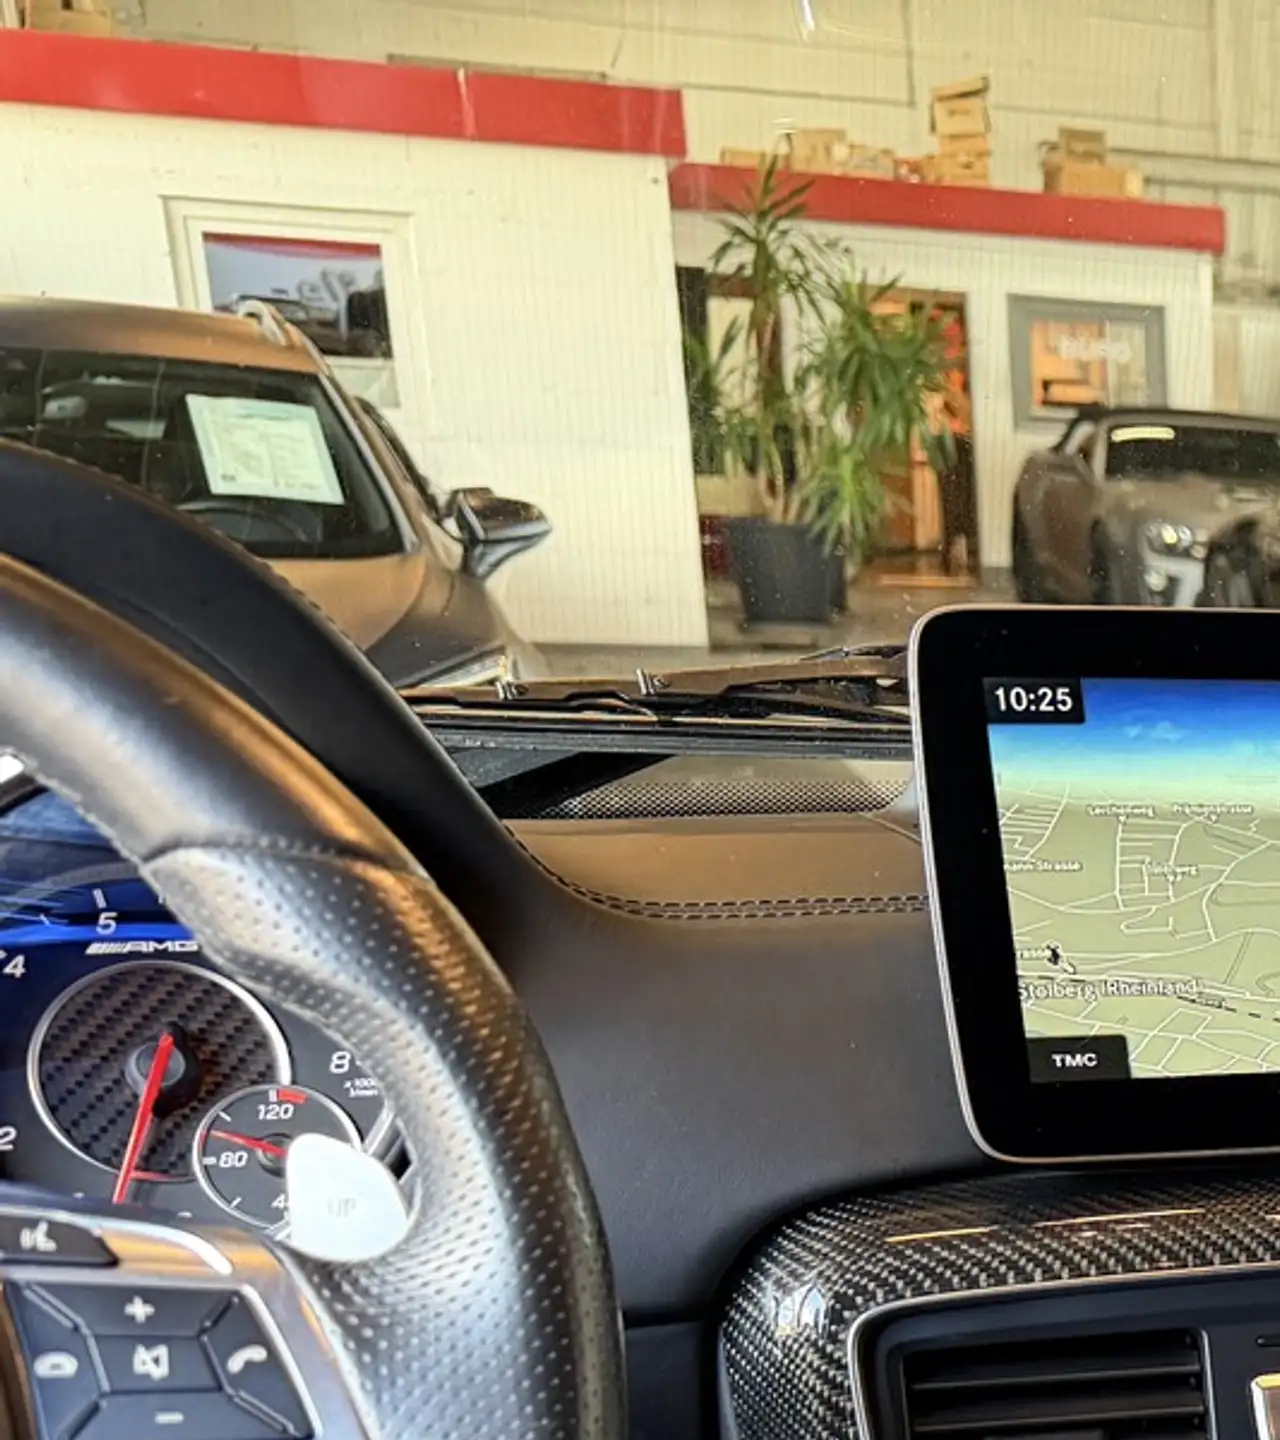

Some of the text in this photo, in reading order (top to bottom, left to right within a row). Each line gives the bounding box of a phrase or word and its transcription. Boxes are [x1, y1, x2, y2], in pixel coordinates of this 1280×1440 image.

[994, 686, 1074, 712] 10:25
[95, 911, 118, 935] 5
[3, 954, 26, 978] 4
[329, 1050, 351, 1074] 8
[1052, 1053, 1098, 1068] TMC
[256, 1104, 294, 1121] 120
[219, 1151, 248, 1169] 80
